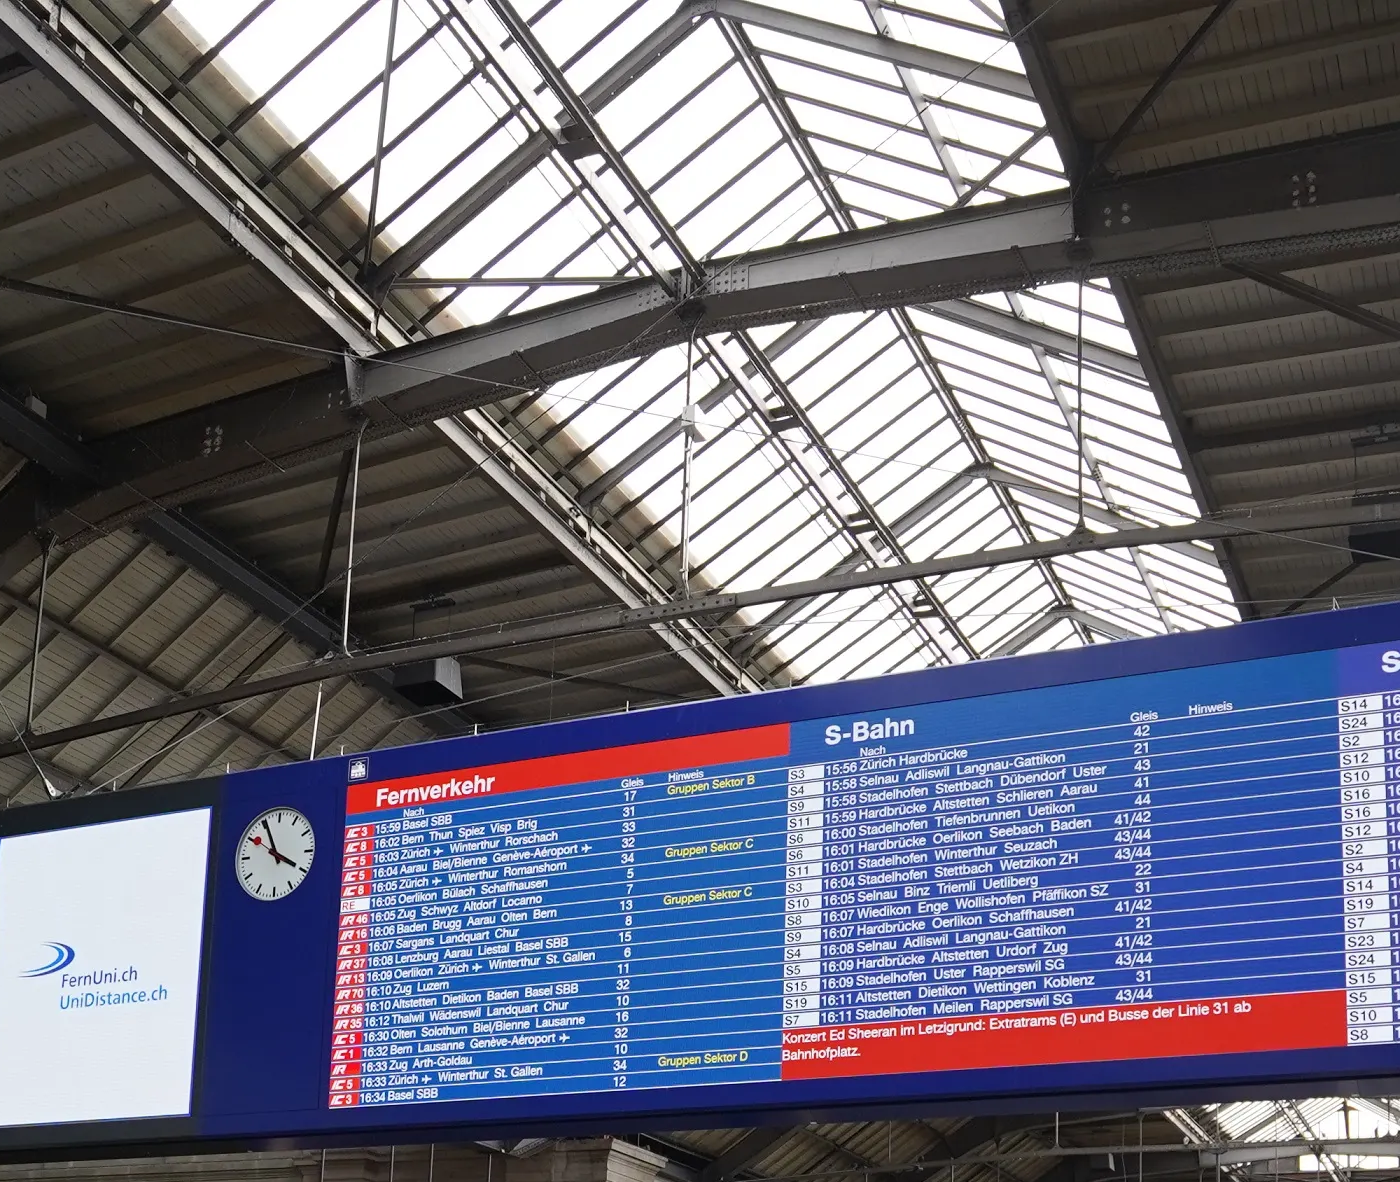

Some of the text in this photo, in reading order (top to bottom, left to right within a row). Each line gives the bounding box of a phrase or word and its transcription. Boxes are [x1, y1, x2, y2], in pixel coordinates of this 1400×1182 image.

[1130, 701, 1233, 722] Gleis Hinweis
[1340, 699, 1368, 712] S14
[824, 718, 914, 745] S-Bahn
[790, 724, 1149, 779] S3 15:56 Zürich Hardbrücke 42
[860, 746, 886, 757] Nach
[376, 775, 495, 807] Fernverkehr
[621, 770, 704, 788] Gleis Hinweis
[361, 826, 368, 837] 3
[375, 821, 400, 834] 15:59
[402, 817, 428, 830] Basel
[430, 814, 452, 826] SBB
[624, 790, 636, 801] 17
[667, 776, 709, 794] Gruppen
[712, 777, 744, 789] Sektor
[747, 774, 754, 784] B
[1343, 788, 1369, 801] S16
[403, 807, 424, 818] Nach
[372, 836, 635, 878] 16:04 Aarau Biel/Bienne Genève-Aéroport 32
[342, 868, 633, 911] RE 16:05 Oerlikon Bülach Schaffhausen 5
[787, 863, 1151, 909] S10 16:05 Selnau Binz Triemli Uetliberg 22
[356, 929, 367, 939] 16
[369, 924, 394, 937] 16:06
[396, 922, 427, 932] Baden
[432, 919, 461, 930] Brugg
[466, 915, 495, 926] Aarau
[501, 911, 527, 922] Olten
[533, 908, 556, 919] Bern
[619, 899, 632, 910] 13
[663, 893, 705, 905] Gruppen
[708, 889, 741, 900] Sektor
[743, 886, 751, 896] C
[62, 966, 138, 988] FernUni.ch
[785, 969, 1150, 1008] S19 16:11 Altstetten Dietikon Wettingen Koblenz 31
[60, 985, 167, 1010] UniDistance.ch
[782, 1000, 1252, 1044] Konzert Ed Sheeran im Letzigrund: Extratrams (E) und Busse der Linie 31 ab
[1350, 1029, 1368, 1040] S8
[782, 1046, 861, 1061] Bahnhofplatz.
